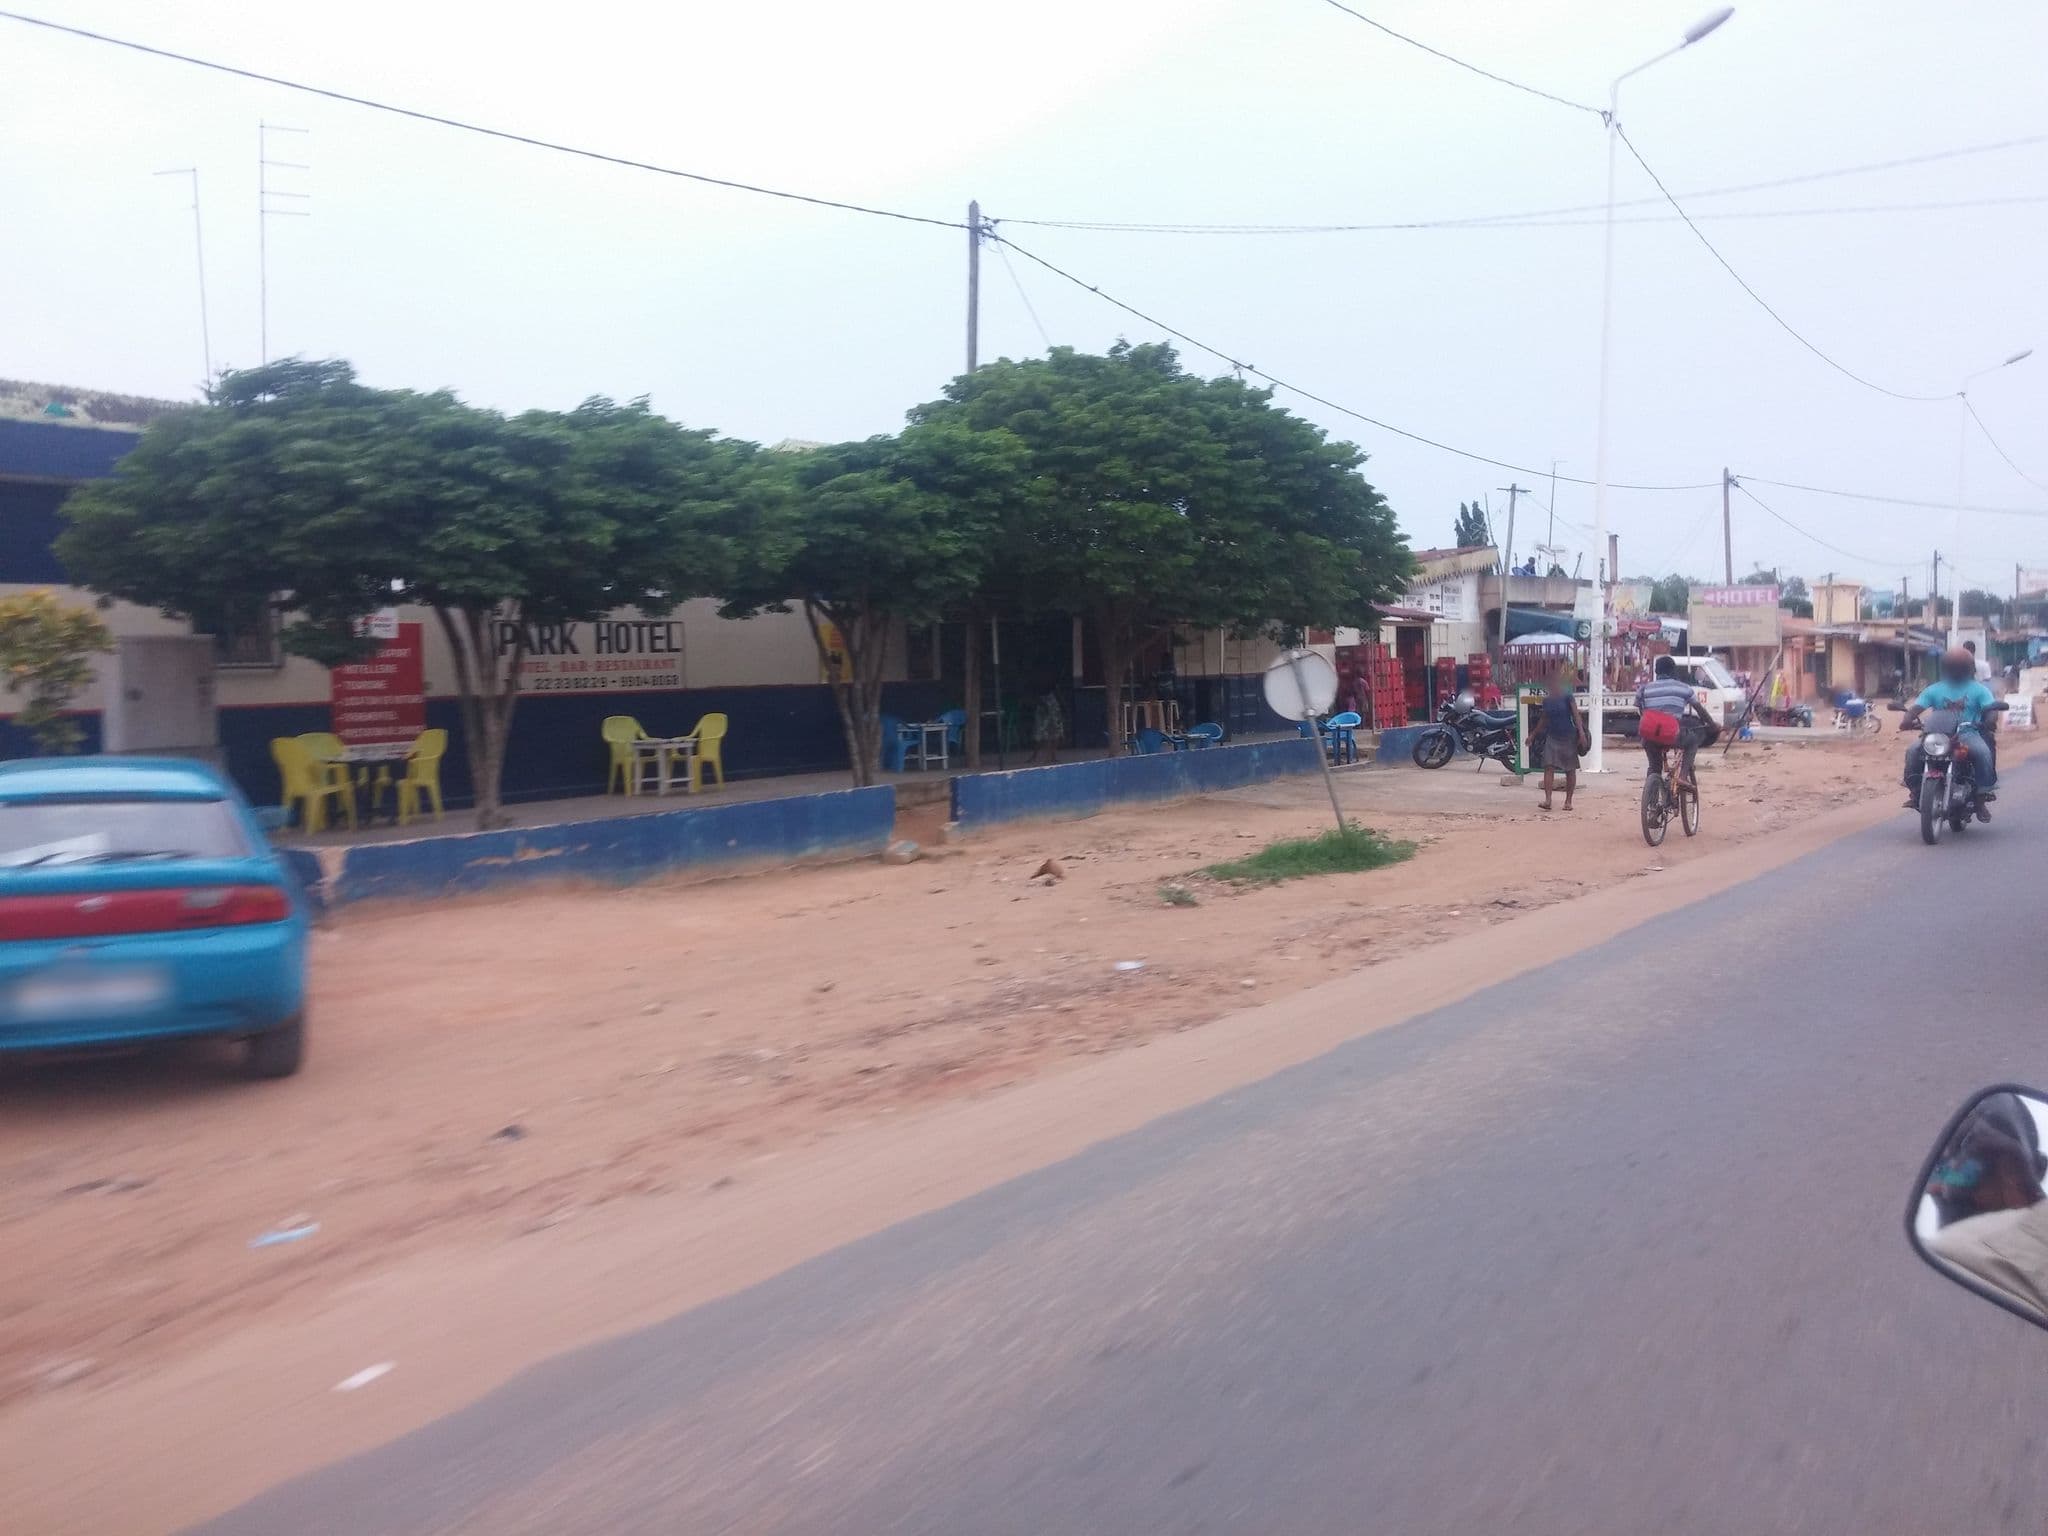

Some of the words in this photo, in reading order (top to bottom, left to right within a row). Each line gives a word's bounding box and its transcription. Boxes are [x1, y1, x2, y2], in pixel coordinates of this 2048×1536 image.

[1716, 588, 1777, 604] HOTEL
[500, 622, 580, 656] PARK
[597, 621, 682, 654] HOTEL
